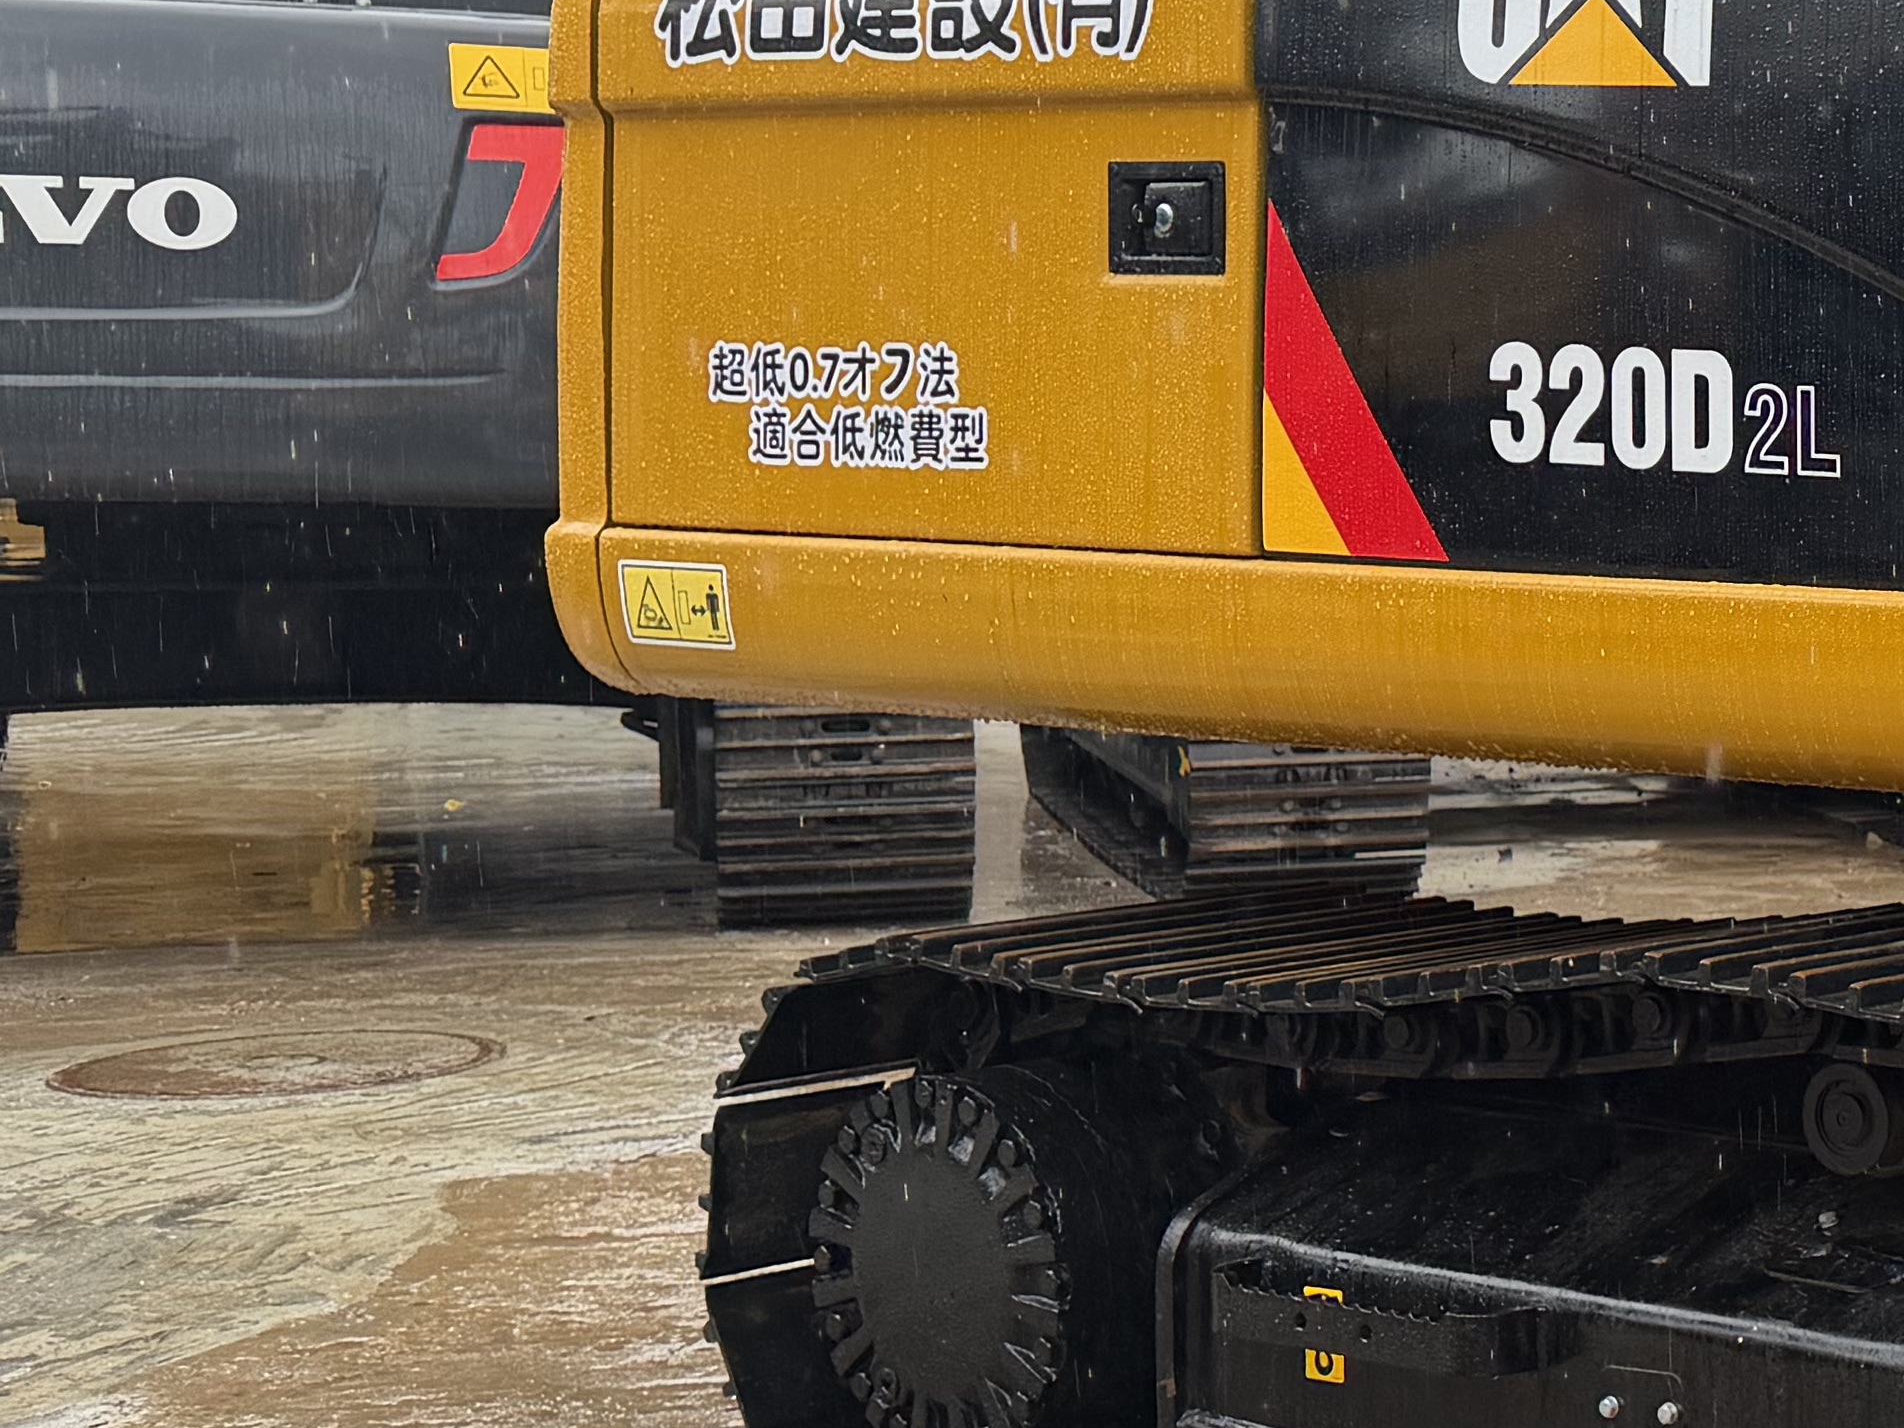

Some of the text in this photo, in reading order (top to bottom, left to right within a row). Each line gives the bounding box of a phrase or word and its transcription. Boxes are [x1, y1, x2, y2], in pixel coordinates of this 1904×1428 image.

[0, 174, 238, 250] VO
[749, 402, 988, 470] 適合低燃費型
